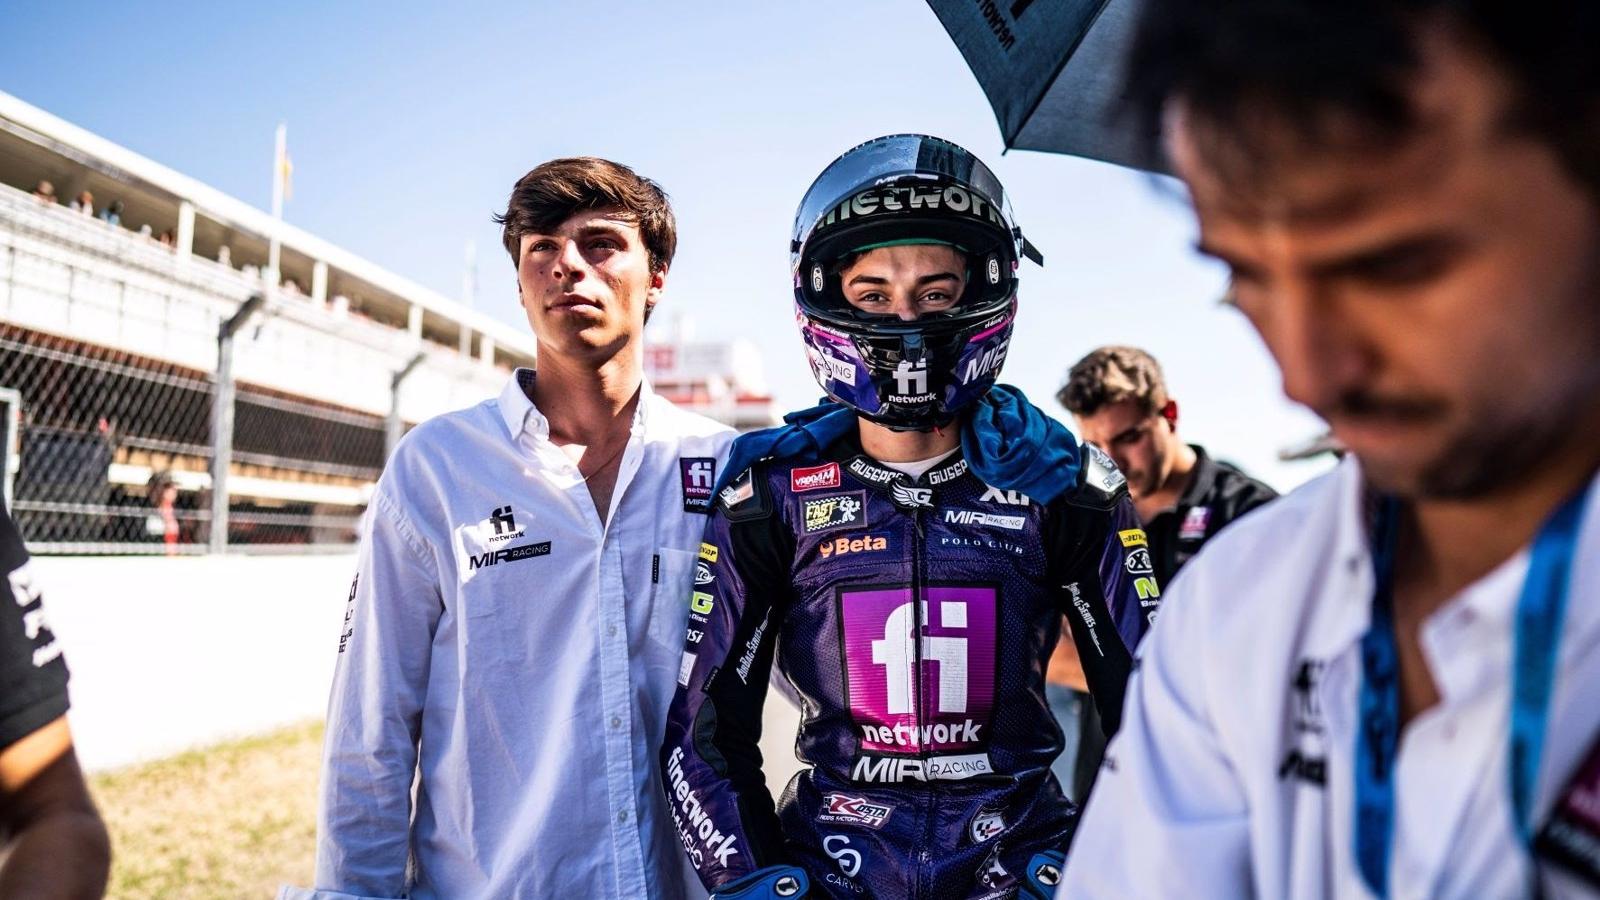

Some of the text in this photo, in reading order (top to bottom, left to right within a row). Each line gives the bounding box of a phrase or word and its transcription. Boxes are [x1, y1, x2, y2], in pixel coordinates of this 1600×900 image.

[888, 392, 937, 404] network
[688, 462, 712, 487] fi
[686, 487, 711, 495] netwo
[490, 505, 516, 535] fi
[806, 502, 837, 520] FAST
[945, 511, 1021, 527] MIR RACING
[489, 531, 525, 543] network
[836, 535, 887, 555] Beta
[941, 537, 981, 546] POLO
[469, 544, 550, 570] MIR RACING
[871, 600, 968, 714] fi
[861, 719, 983, 746] network
[852, 756, 986, 783] MIR RACING
[667, 746, 738, 868] finetwork
